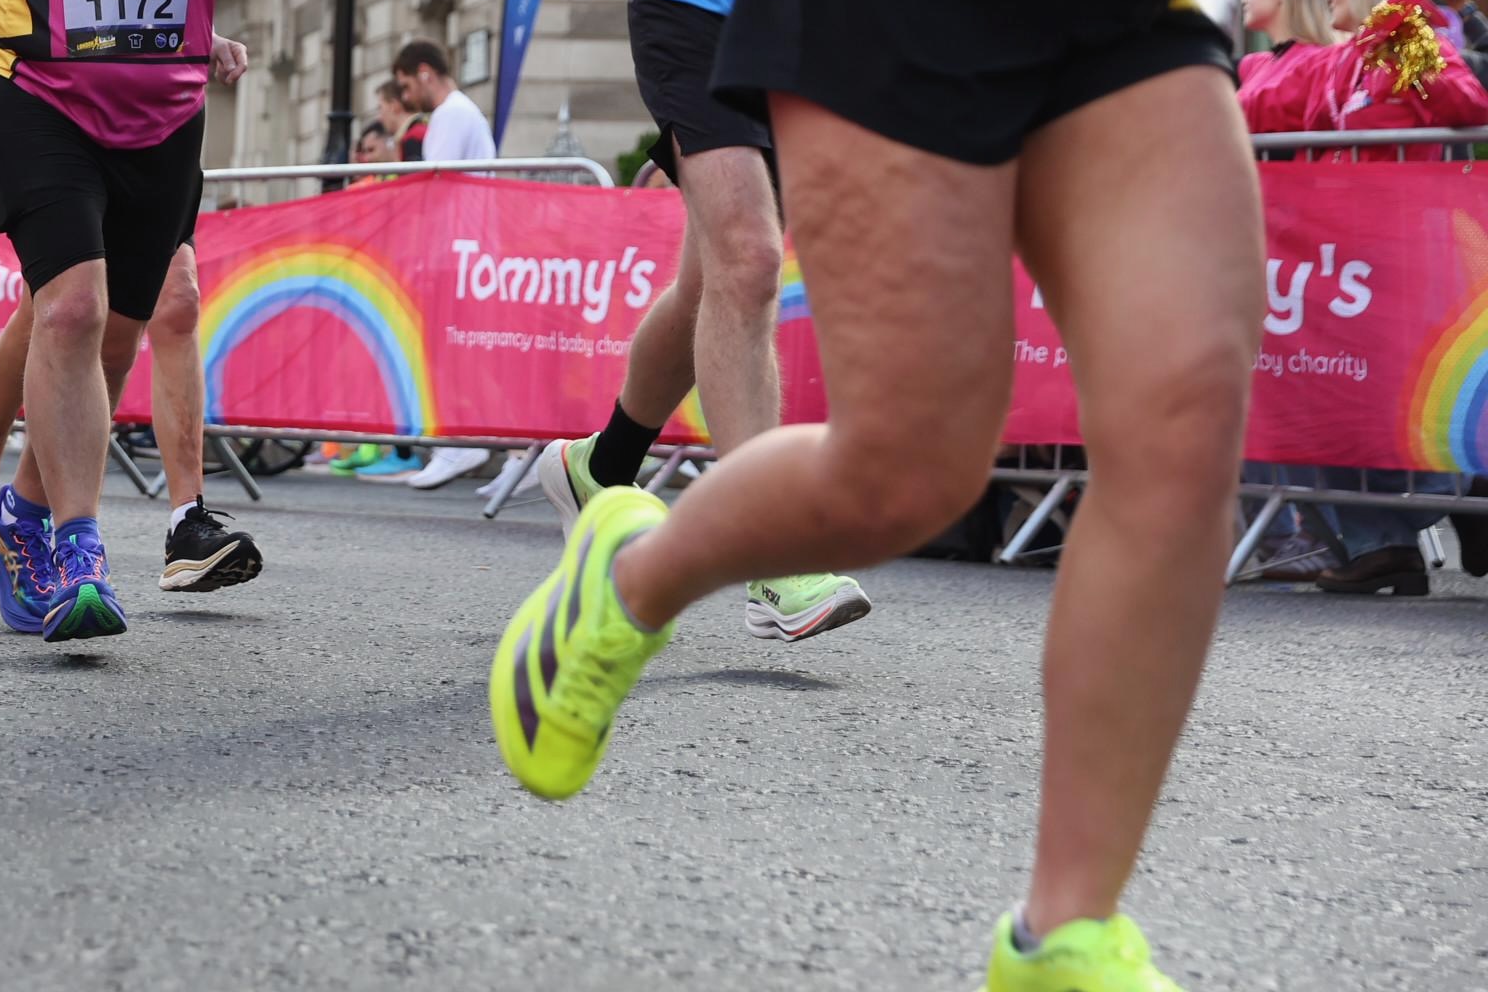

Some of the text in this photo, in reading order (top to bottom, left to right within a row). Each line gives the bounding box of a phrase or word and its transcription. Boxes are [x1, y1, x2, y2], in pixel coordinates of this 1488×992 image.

[451, 239, 657, 324] Tommy's
[446, 325, 466, 344] The
[467, 330, 534, 352] pregnancy
[534, 331, 557, 351] and
[558, 332, 594, 358] baby
[1013, 338, 1049, 364] The
[1288, 345, 1368, 382] charity
[761, 583, 781, 609] HOKA
